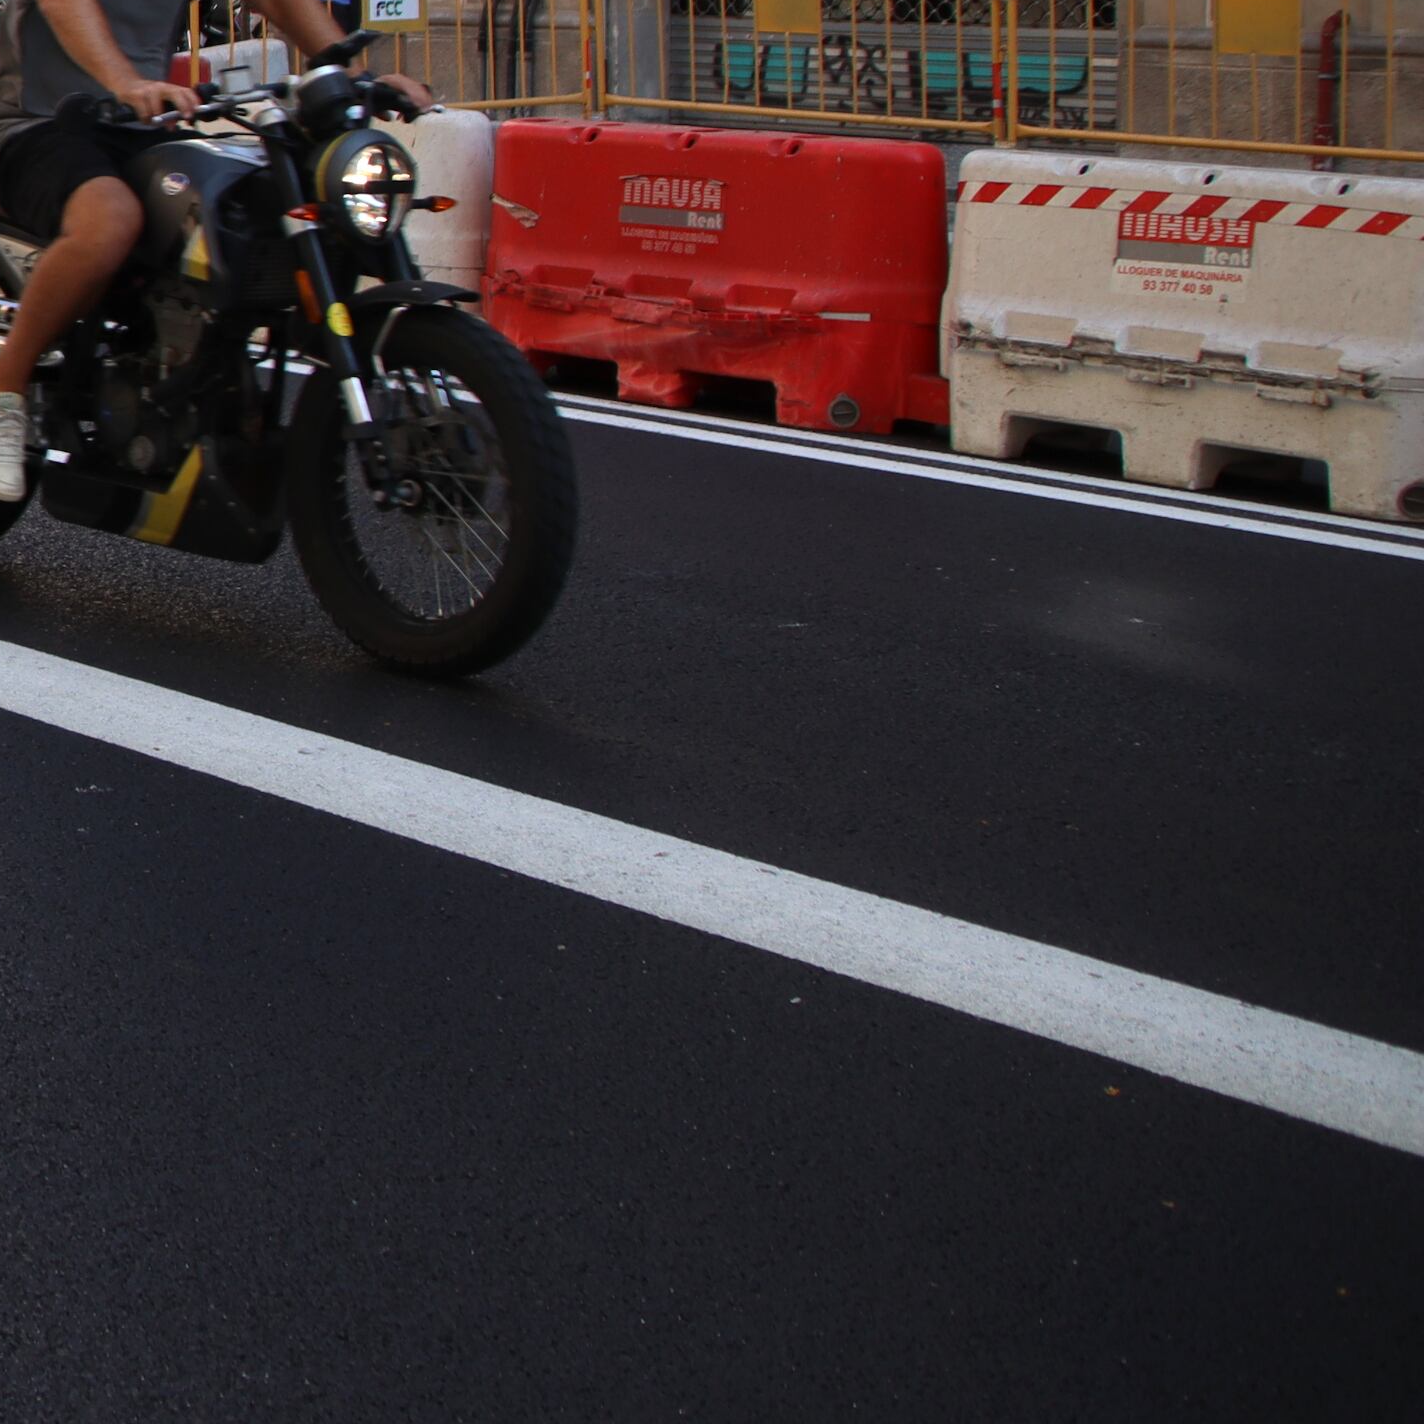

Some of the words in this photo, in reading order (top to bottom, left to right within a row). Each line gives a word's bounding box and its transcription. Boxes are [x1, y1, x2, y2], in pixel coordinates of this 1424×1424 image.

[376, 0, 403, 17] FCC
[623, 176, 722, 210] MAUSA
[687, 211, 723, 230] Rent
[1203, 246, 1250, 267] Rent
[1117, 265, 1162, 277] LLOGUER
[1164, 268, 1178, 278] DE
[1142, 279, 1156, 291] 93
[1160, 281, 1179, 293] 377
[1182, 282, 1196, 294] 40
